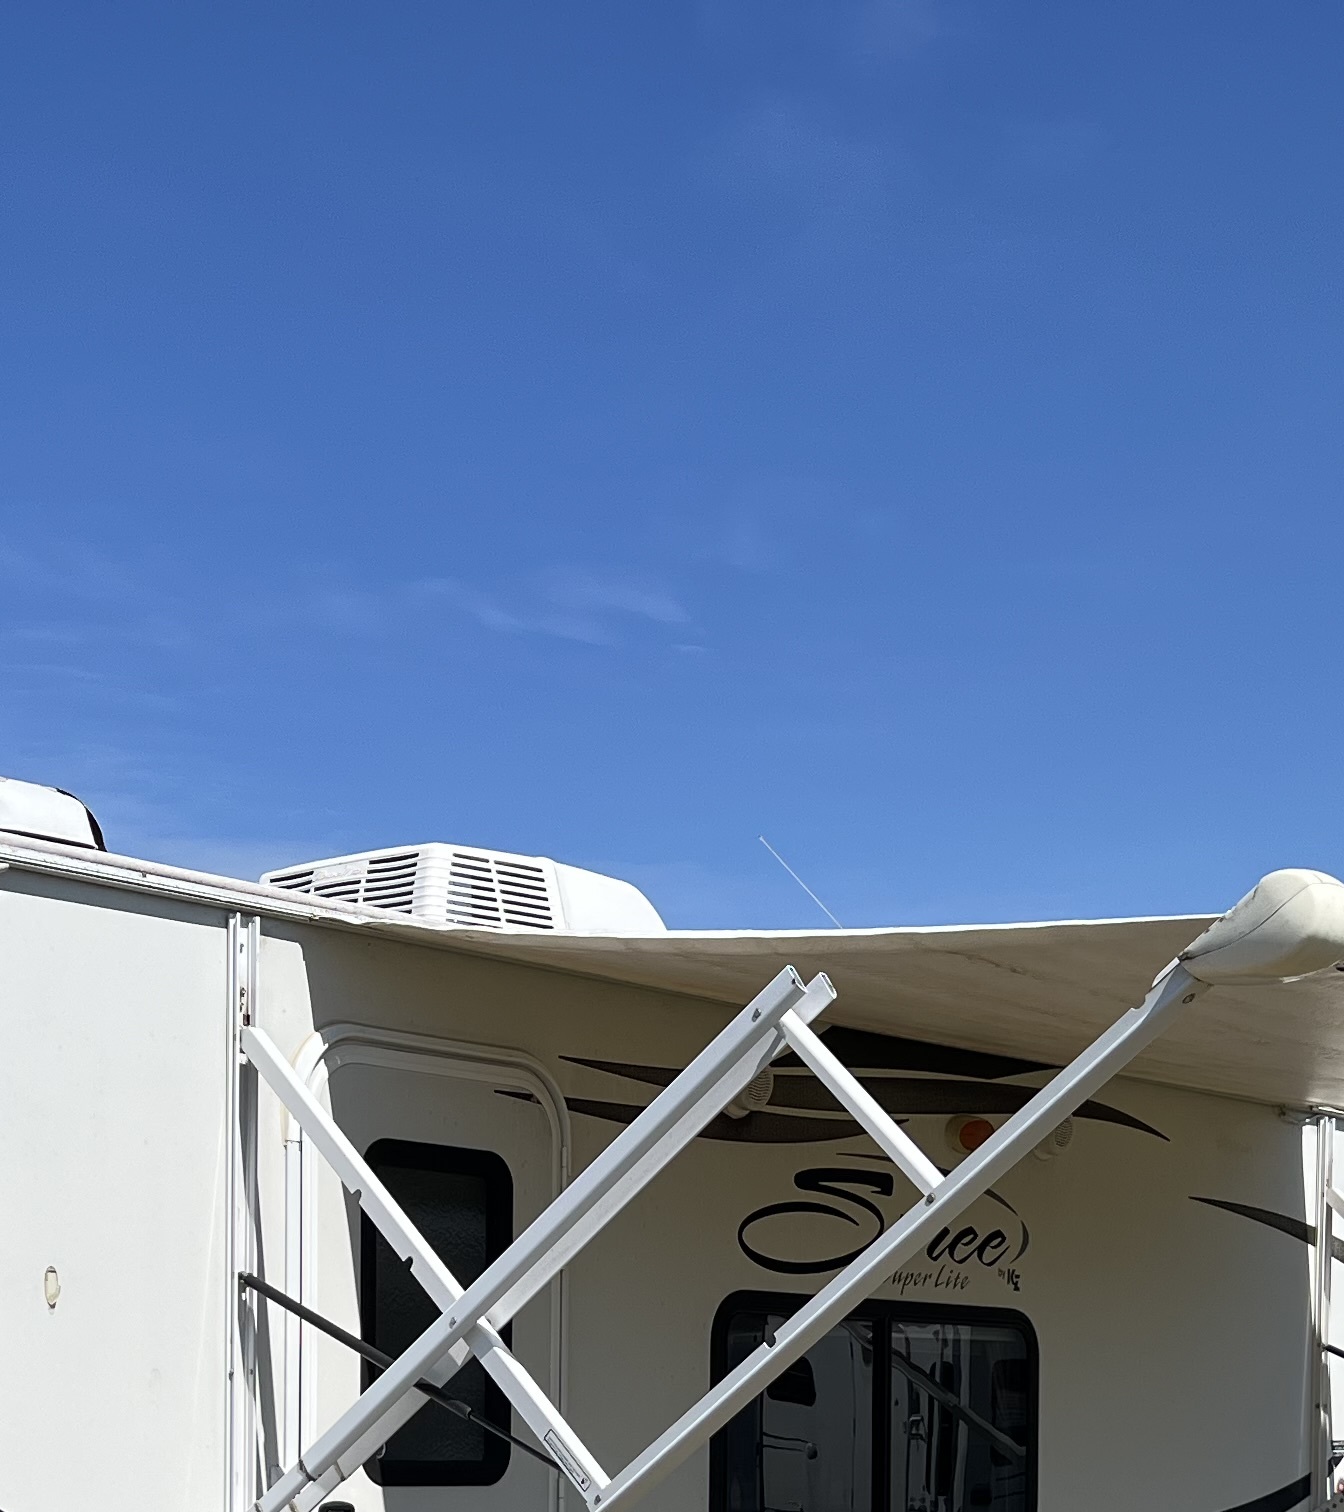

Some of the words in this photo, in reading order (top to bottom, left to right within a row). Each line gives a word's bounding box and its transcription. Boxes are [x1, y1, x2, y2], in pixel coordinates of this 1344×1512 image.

[737, 1167, 1011, 1275] See
[882, 1269, 933, 1296] uper
[934, 1264, 971, 1291] Lite
